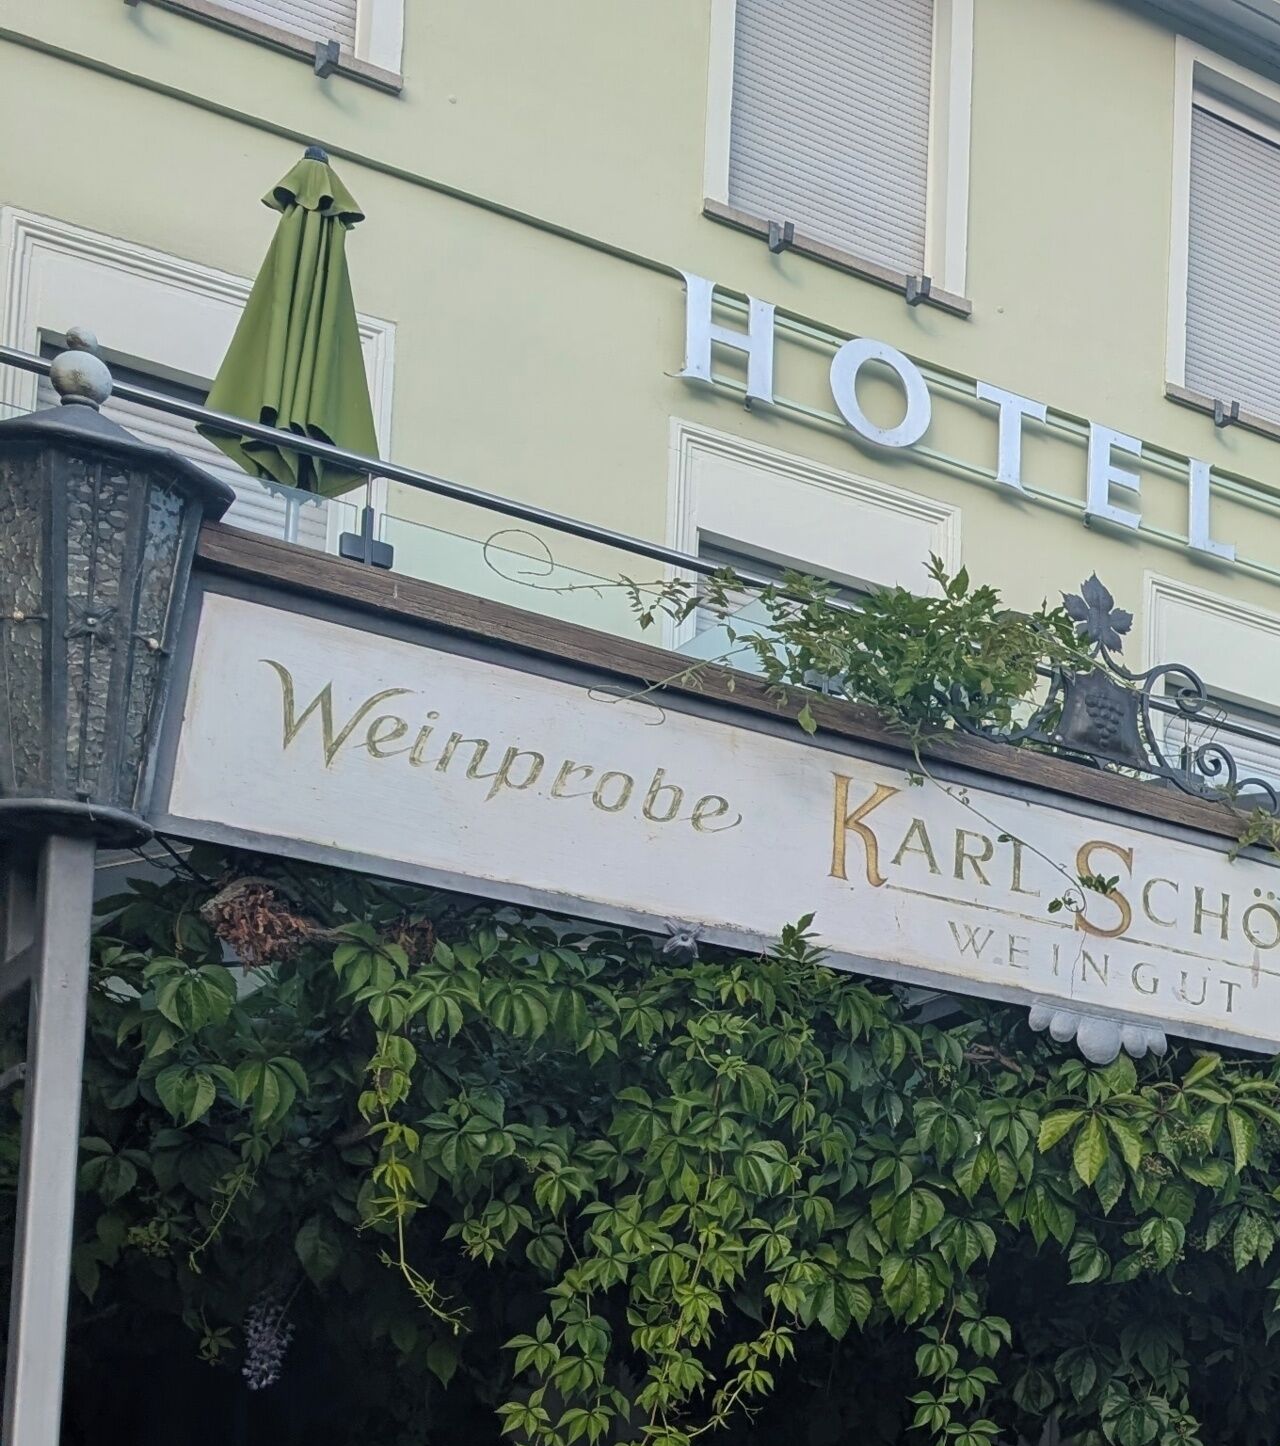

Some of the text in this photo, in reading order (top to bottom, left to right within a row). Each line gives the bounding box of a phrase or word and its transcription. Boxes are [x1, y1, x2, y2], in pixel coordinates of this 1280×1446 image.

[667, 270, 1236, 562] HOTEL
[258, 658, 743, 833] Weinprobe
[948, 920, 1241, 1013] WEINGUT
